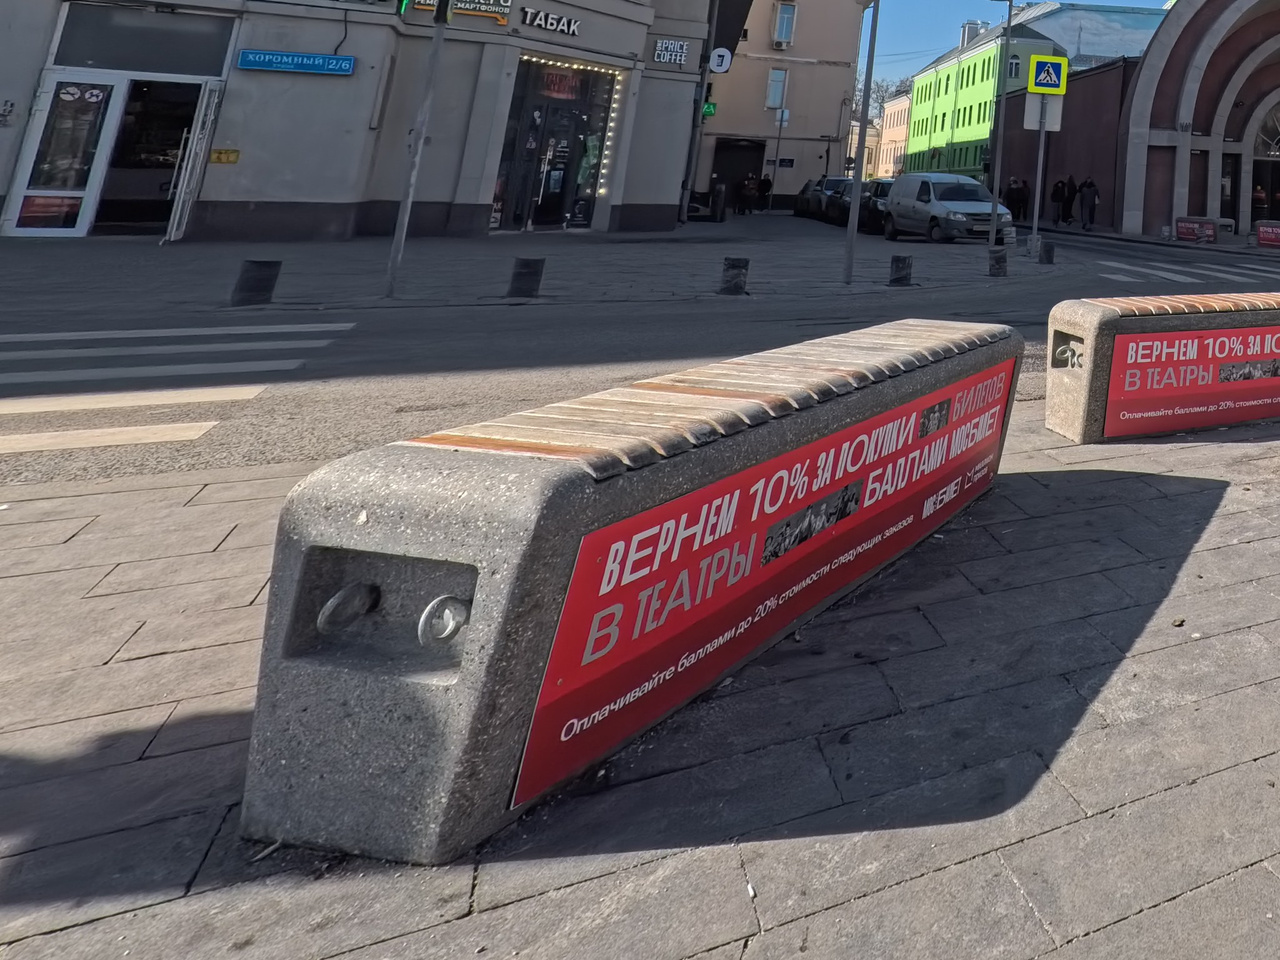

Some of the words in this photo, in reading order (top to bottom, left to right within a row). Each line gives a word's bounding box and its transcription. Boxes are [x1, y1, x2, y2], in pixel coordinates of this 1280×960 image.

[523, 7, 582, 36] ТАБАК
[654, 50, 687, 64] COFFEE
[662, 40, 690, 53] PRICE
[246, 53, 323, 66] ХОРОМНЫЙ
[328, 60, 350, 70] 2/6
[1127, 339, 1198, 364] ВЕРНЕМ
[1204, 336, 1243, 359] 10%
[1247, 335, 1261, 355] ЗА
[1125, 369, 1141, 391] В
[1147, 364, 1213, 389] ТЕАТРЫ
[1120, 407, 1173, 420] Оплачивайте
[1174, 403, 1207, 415] баллами
[1207, 404, 1218, 413] до
[1219, 400, 1235, 409] 20%
[1235, 399, 1272, 408] стоимости
[599, 489, 741, 596] ВЕРНЕМ
[749, 459, 810, 522] 10%
[812, 448, 836, 493] ЗА
[835, 412, 917, 480] ПОКУПКИ
[952, 371, 1006, 422] БИЛЕТОВ
[581, 603, 624, 667] В
[632, 533, 758, 640] ТЕАТРЫ
[863, 434, 949, 508] БАЛЛАМИ
[949, 405, 1001, 460] МОСБИЛЕТ
[560, 666, 676, 742] Оплачивайте
[677, 627, 736, 673] баллами
[736, 616, 752, 637] до
[753, 594, 778, 623] 20%
[778, 564, 830, 605] стоимости
[831, 535, 882, 570] следующих
[883, 514, 914, 540] заказов
